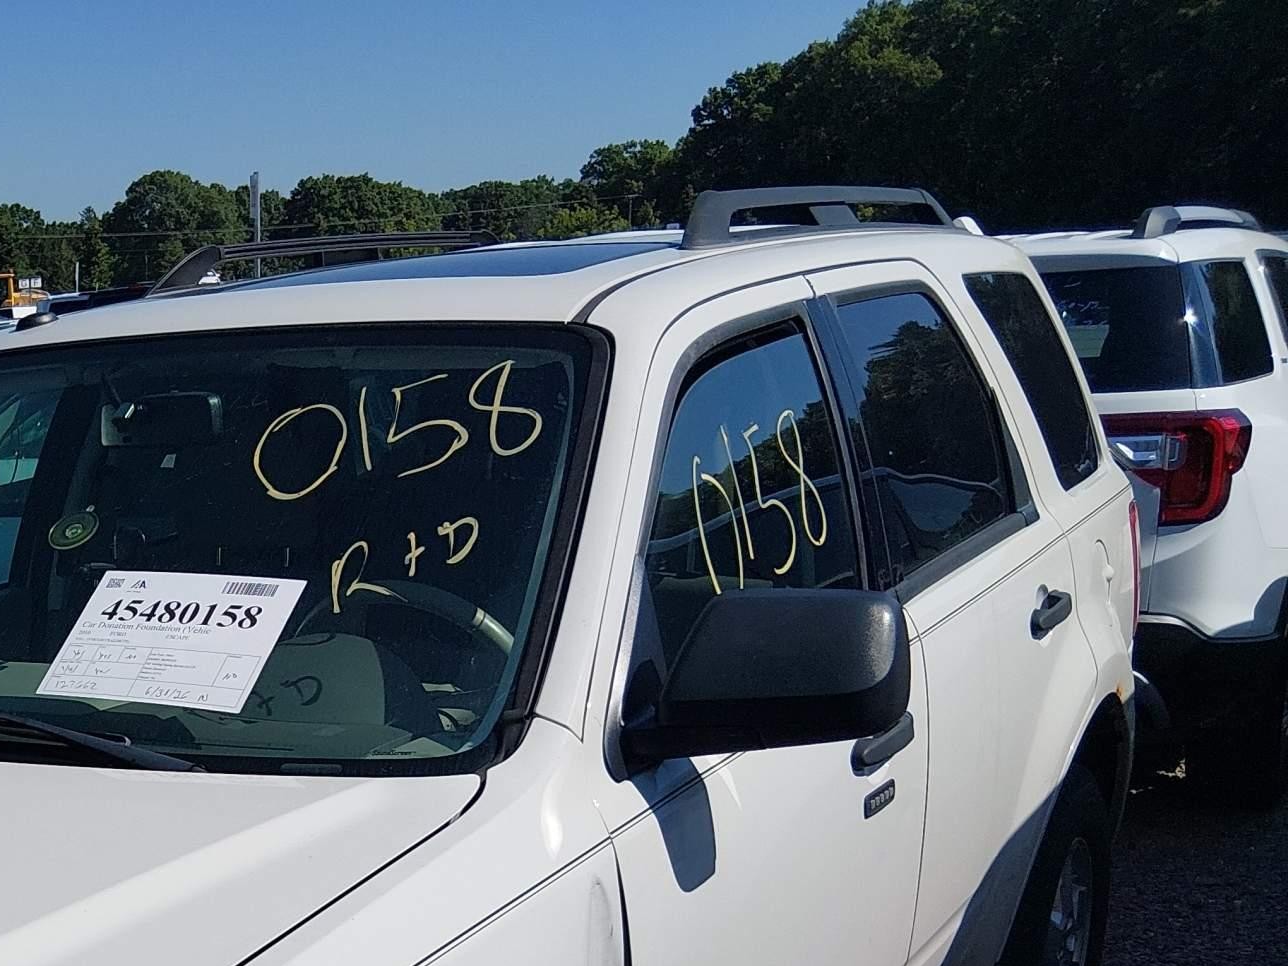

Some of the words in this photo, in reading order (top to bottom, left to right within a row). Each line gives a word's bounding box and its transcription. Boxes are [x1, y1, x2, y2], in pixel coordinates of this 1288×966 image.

[253, 360, 543, 500] 0158
[692, 409, 827, 595] 0158
[331, 540, 409, 613] R
[437, 516, 479, 564] D
[82, 621, 96, 629] Car
[97, 621, 134, 631] Donation
[135, 623, 181, 633] Foundation
[100, 598, 263, 630] 45480158
